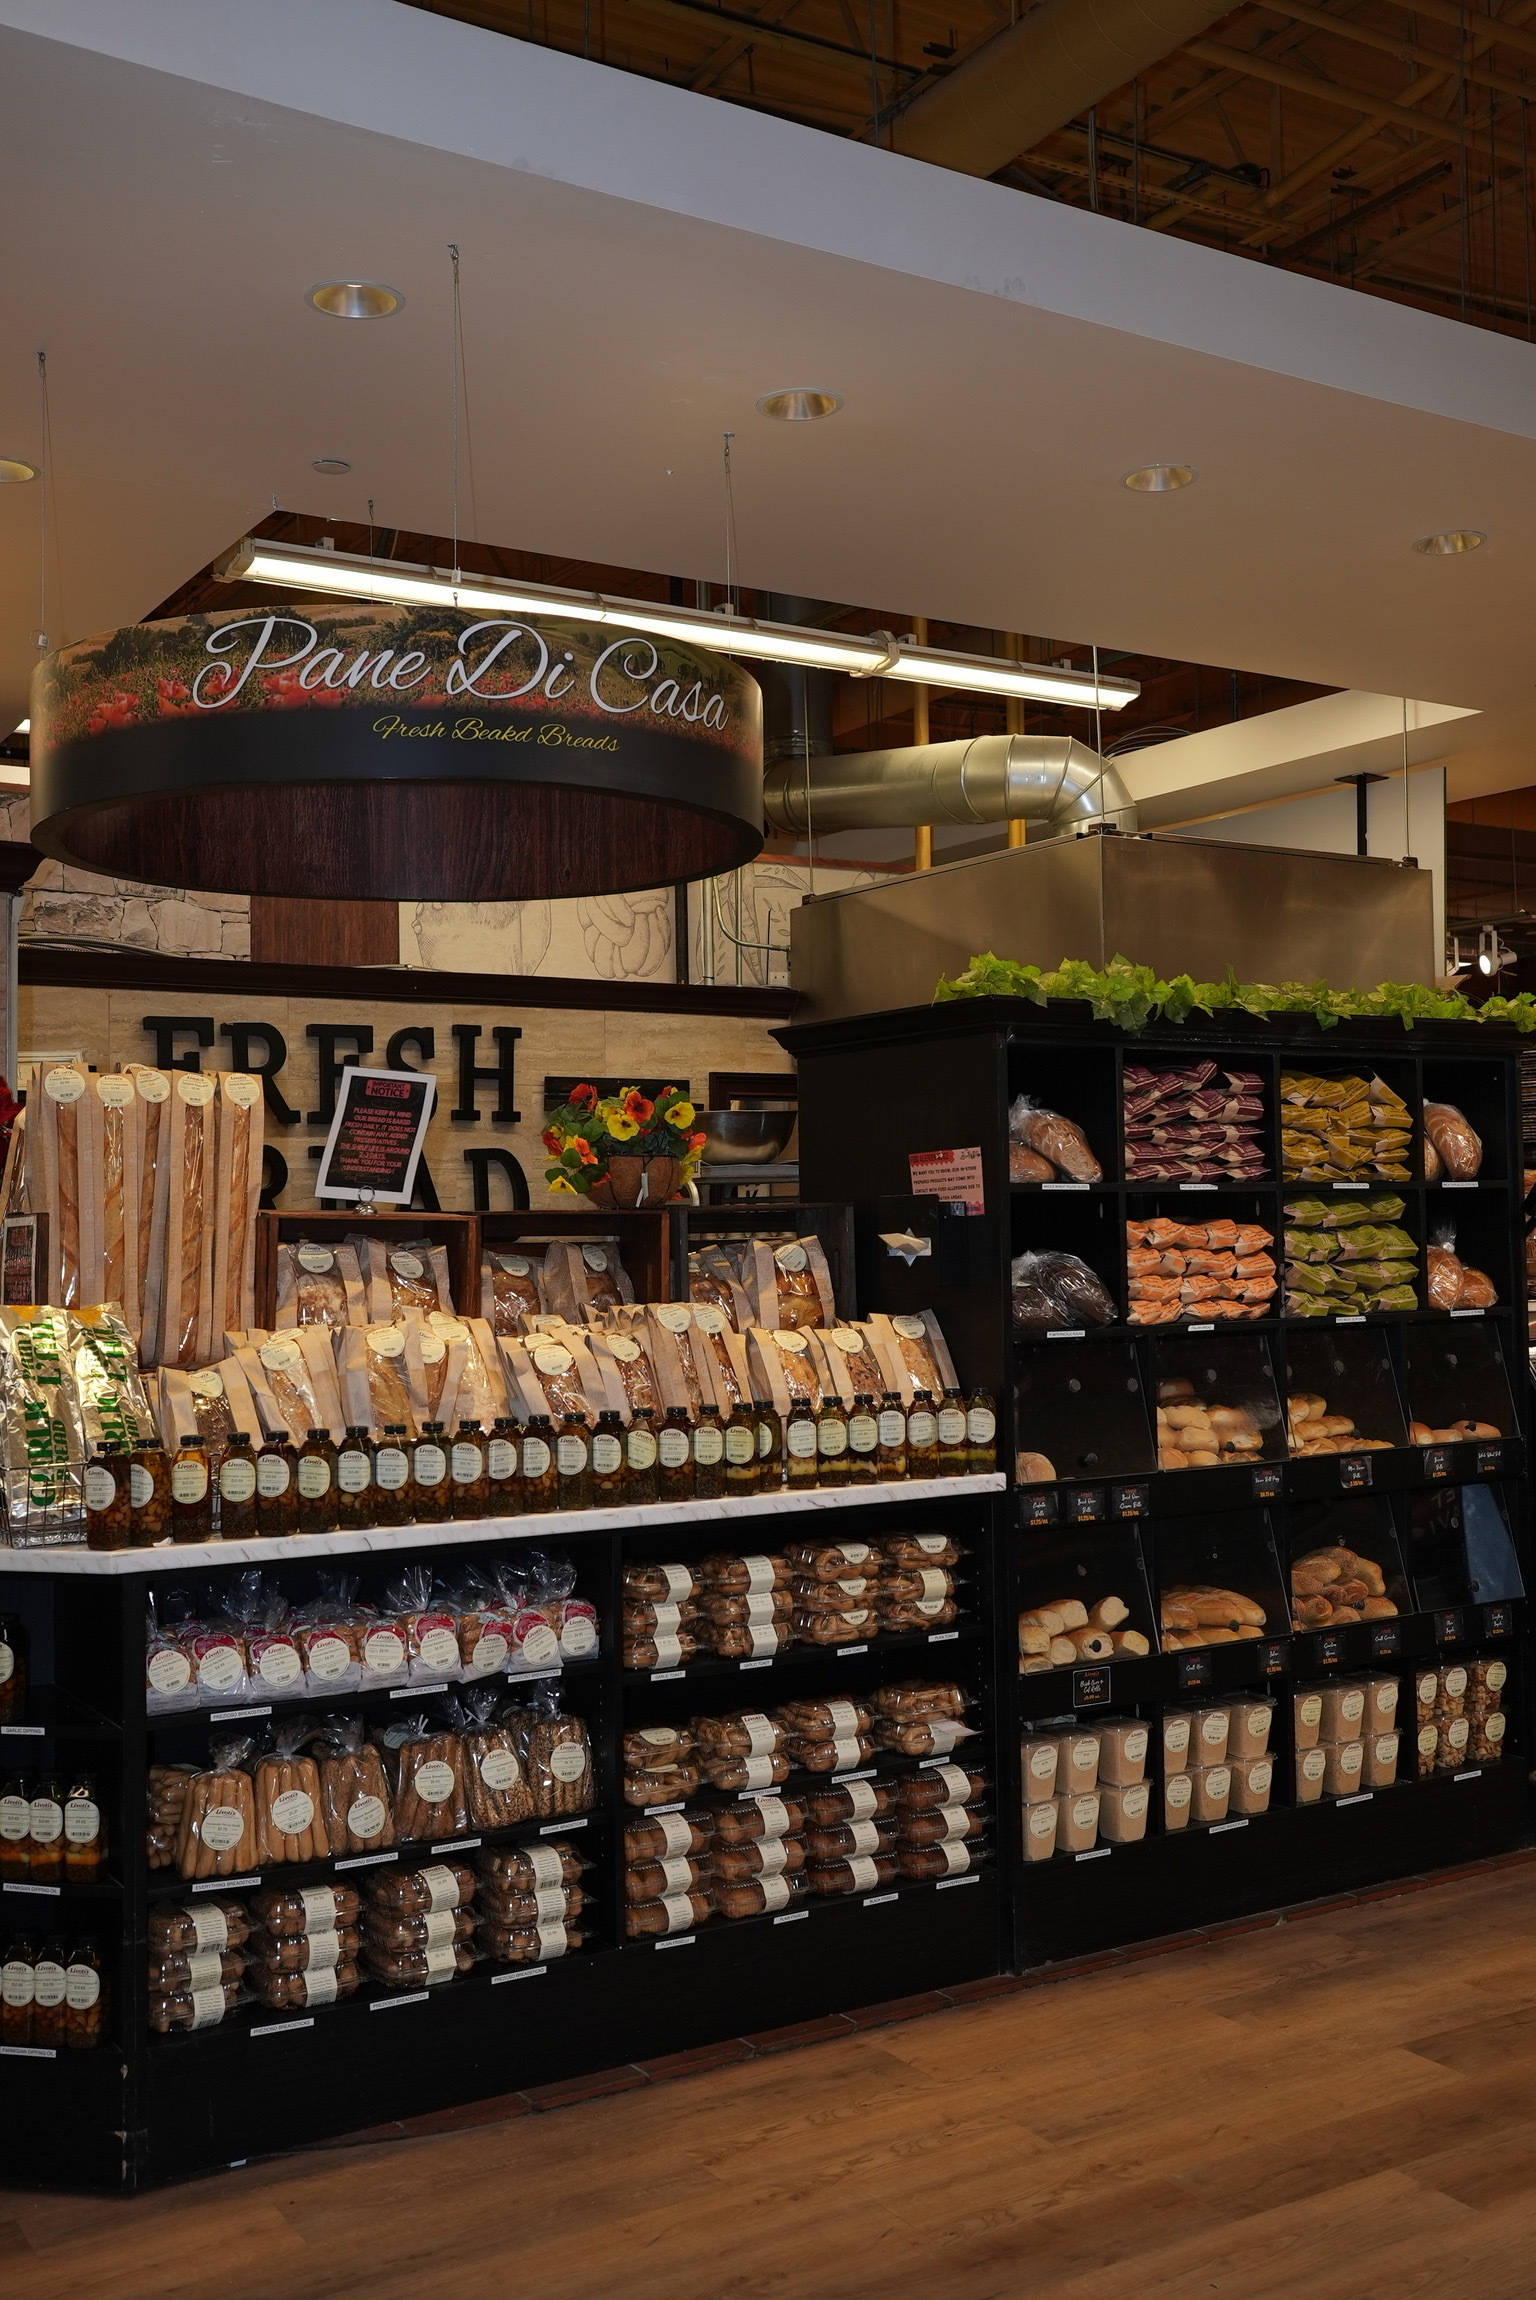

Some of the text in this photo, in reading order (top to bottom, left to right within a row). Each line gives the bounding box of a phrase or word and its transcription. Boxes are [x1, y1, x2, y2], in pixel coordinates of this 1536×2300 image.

[192, 615, 731, 732] Pane Di Casa
[373, 714, 621, 753] Fresh Beakd Breads
[372, 1081, 405, 1089] IMPORTANT
[371, 1087, 404, 1098] NOTICE
[353, 1107, 375, 1115] PLEASE
[344, 1121, 362, 1129] FRESH
[393, 1118, 411, 1126] BAKED
[349, 1129, 376, 1137] CONTAIN
[389, 1132, 408, 1140] ADDED
[351, 1143, 368, 1151] SHELF
[385, 1147, 411, 1155] AROUND
[339, 1157, 359, 1165] THANK
[530, 1670, 560, 1678] BREADSTICKS
[415, 1685, 445, 1694] BREADSTICKS
[238, 1708, 271, 1717] BREADSTICKS
[336, 1853, 397, 1869] EVERYTHING BREADSTICKS
[195, 1879, 259, 1891] EVERYTHING BREADSTICKS
[516, 1968, 545, 1977] BREADSTICKS
[396, 1993, 427, 2003] BREADSTICKS
[278, 2020, 310, 2030] BREADSTICKS
